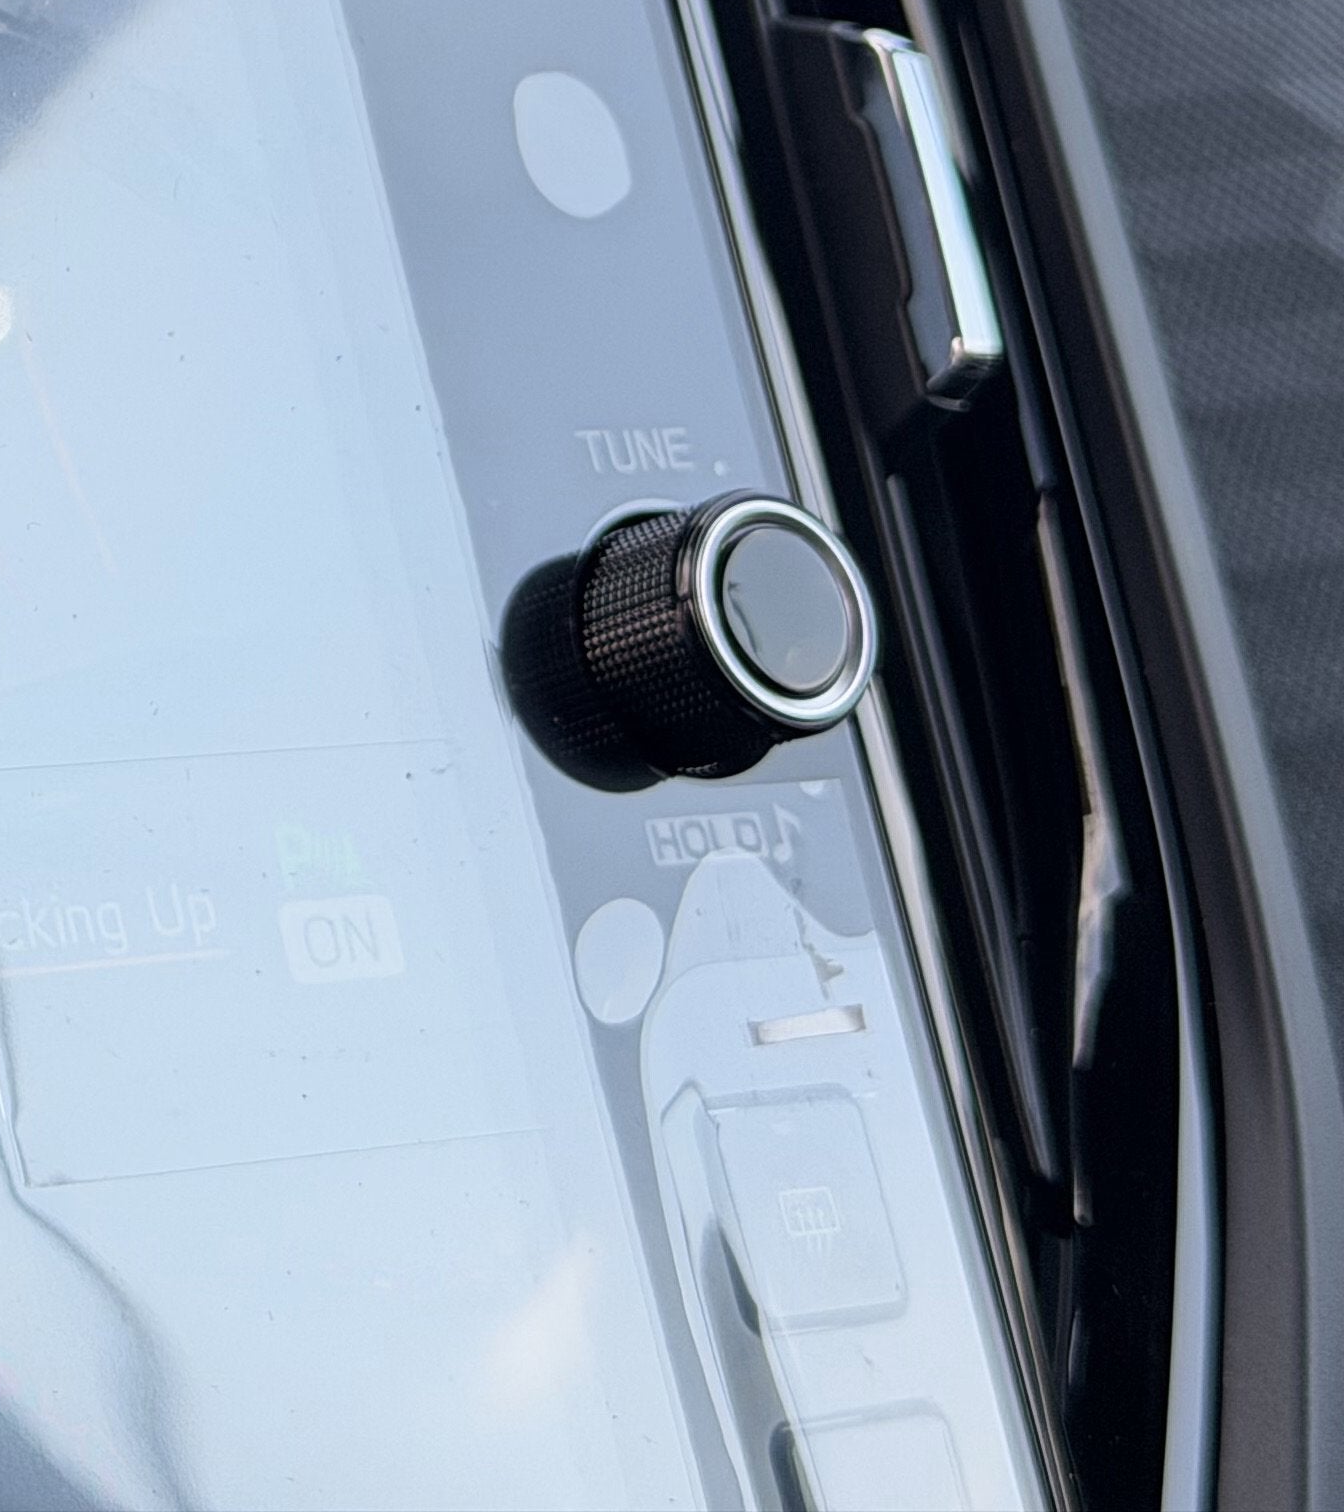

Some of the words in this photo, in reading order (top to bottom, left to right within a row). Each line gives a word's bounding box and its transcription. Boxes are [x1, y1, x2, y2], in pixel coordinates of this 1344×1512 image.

[575, 426, 697, 477] TUNE
[143, 881, 219, 949] Up
[302, 905, 382, 969] ON
